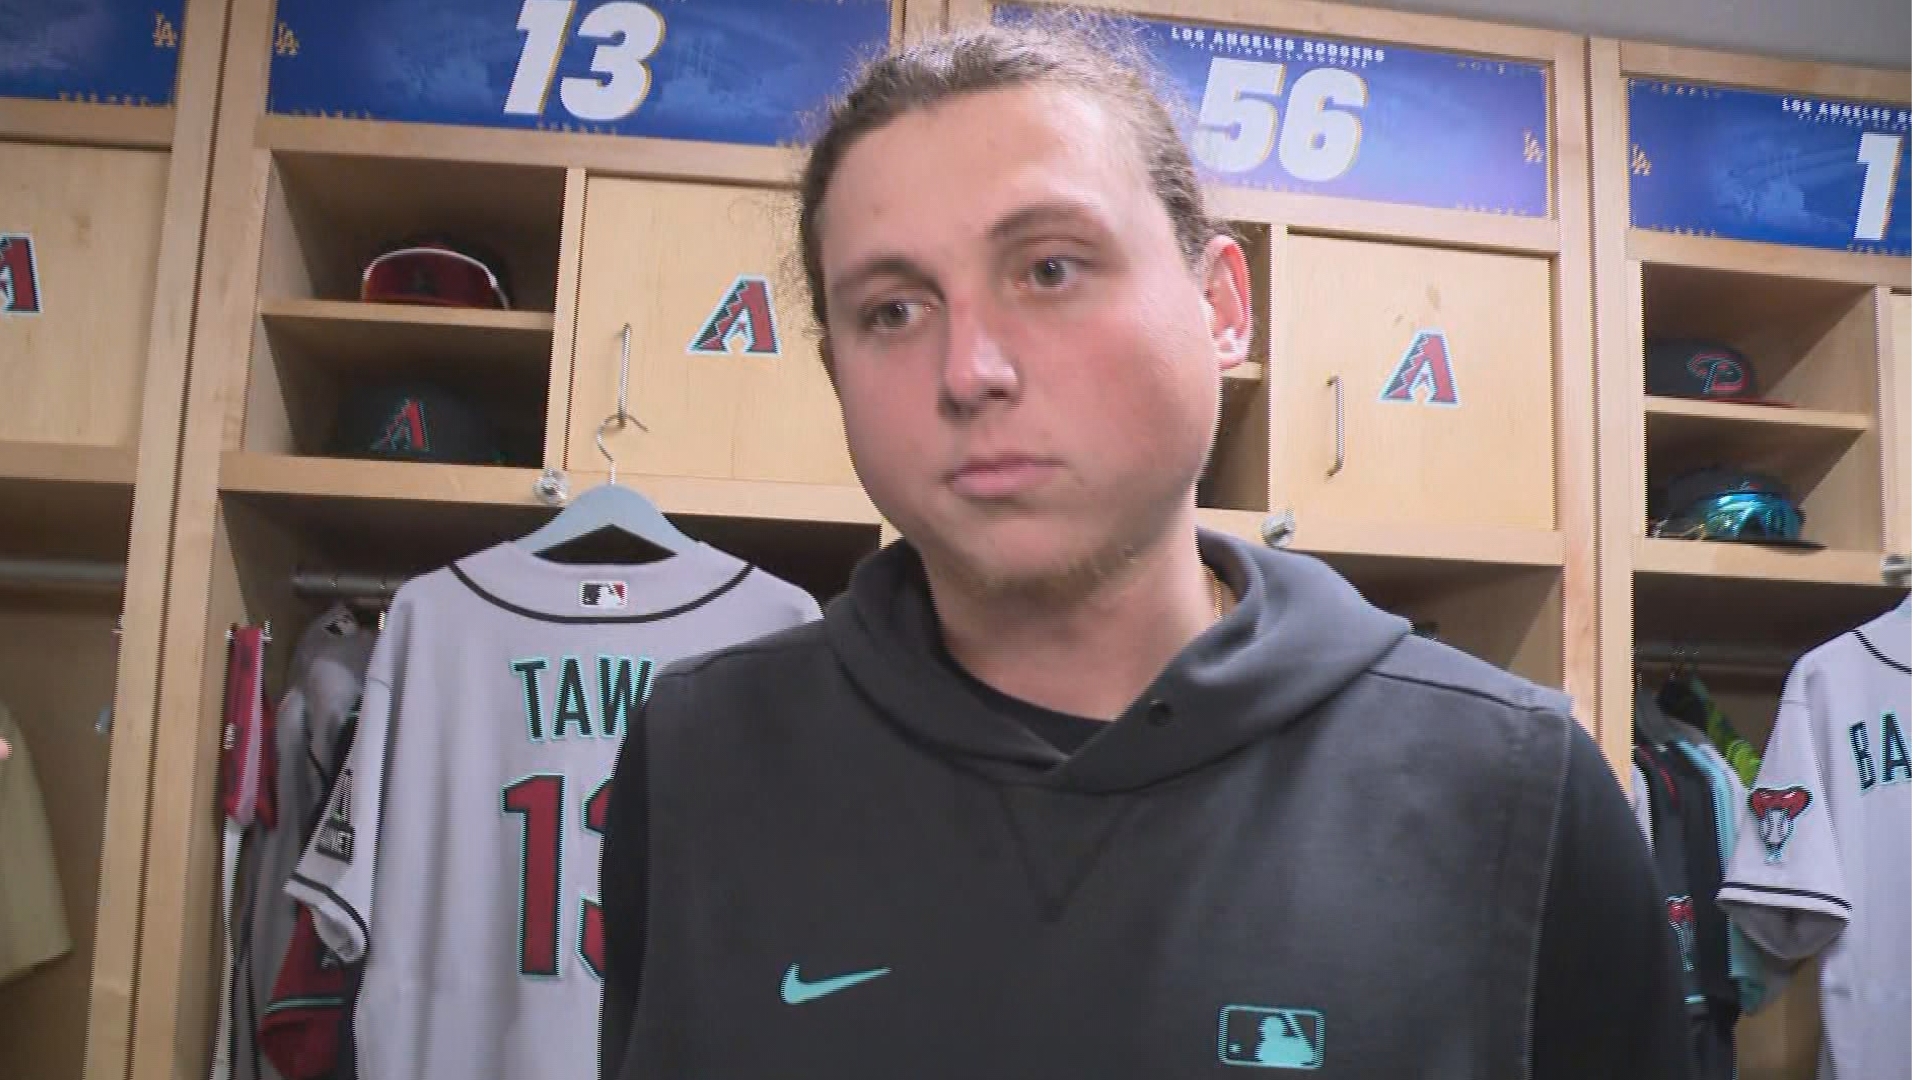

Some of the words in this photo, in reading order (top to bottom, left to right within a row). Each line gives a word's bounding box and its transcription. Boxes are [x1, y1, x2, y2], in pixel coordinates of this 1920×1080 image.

[503, 0, 667, 121] 13
[1171, 26, 1205, 42] LOS
[1213, 31, 1295, 51] ANGELES
[1303, 41, 1386, 62] DODGERS
[1192, 57, 1370, 182] 56
[1781, 98, 1812, 113] LOS
[1818, 102, 1891, 120] ANGELES
[1853, 132, 1904, 241] 1
[509, 655, 655, 742] TAW
